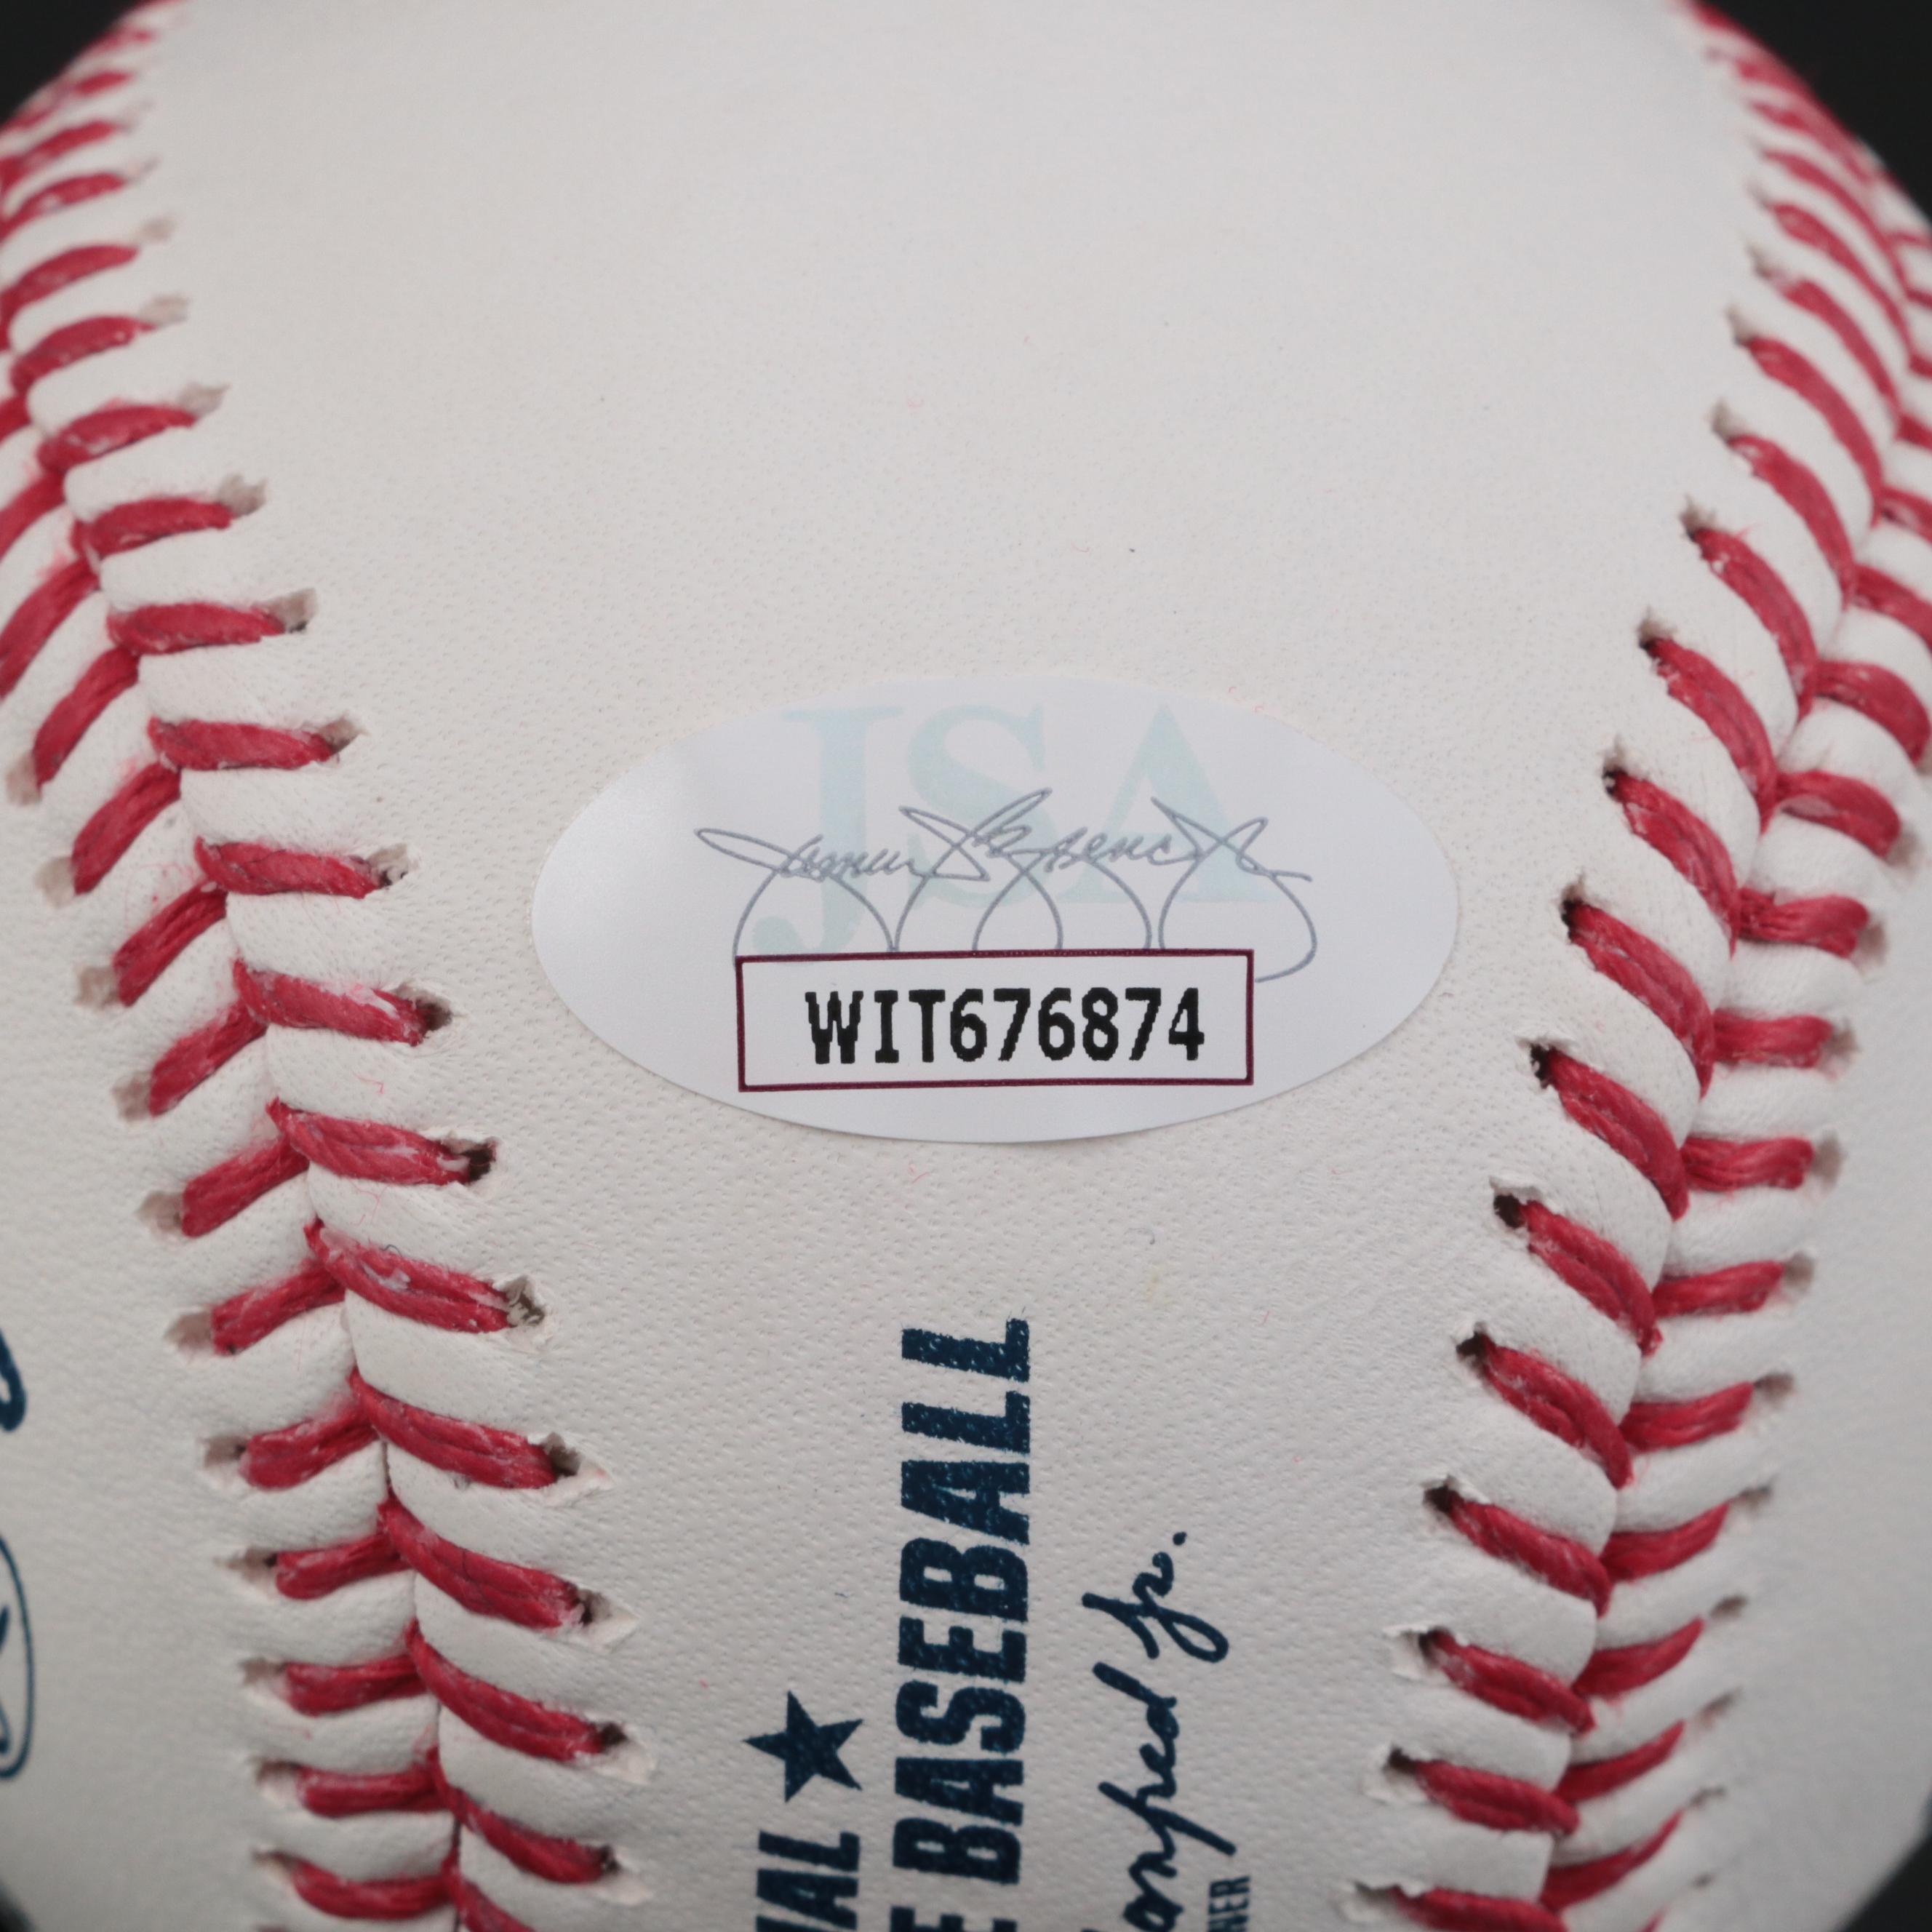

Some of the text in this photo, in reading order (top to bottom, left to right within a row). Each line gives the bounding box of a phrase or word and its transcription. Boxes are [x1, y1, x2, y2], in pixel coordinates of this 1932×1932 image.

[753, 702, 1284, 951] JSA
[804, 986, 1205, 1066] WIT676874
[891, 1317, 1031, 1885] BASEBALL
